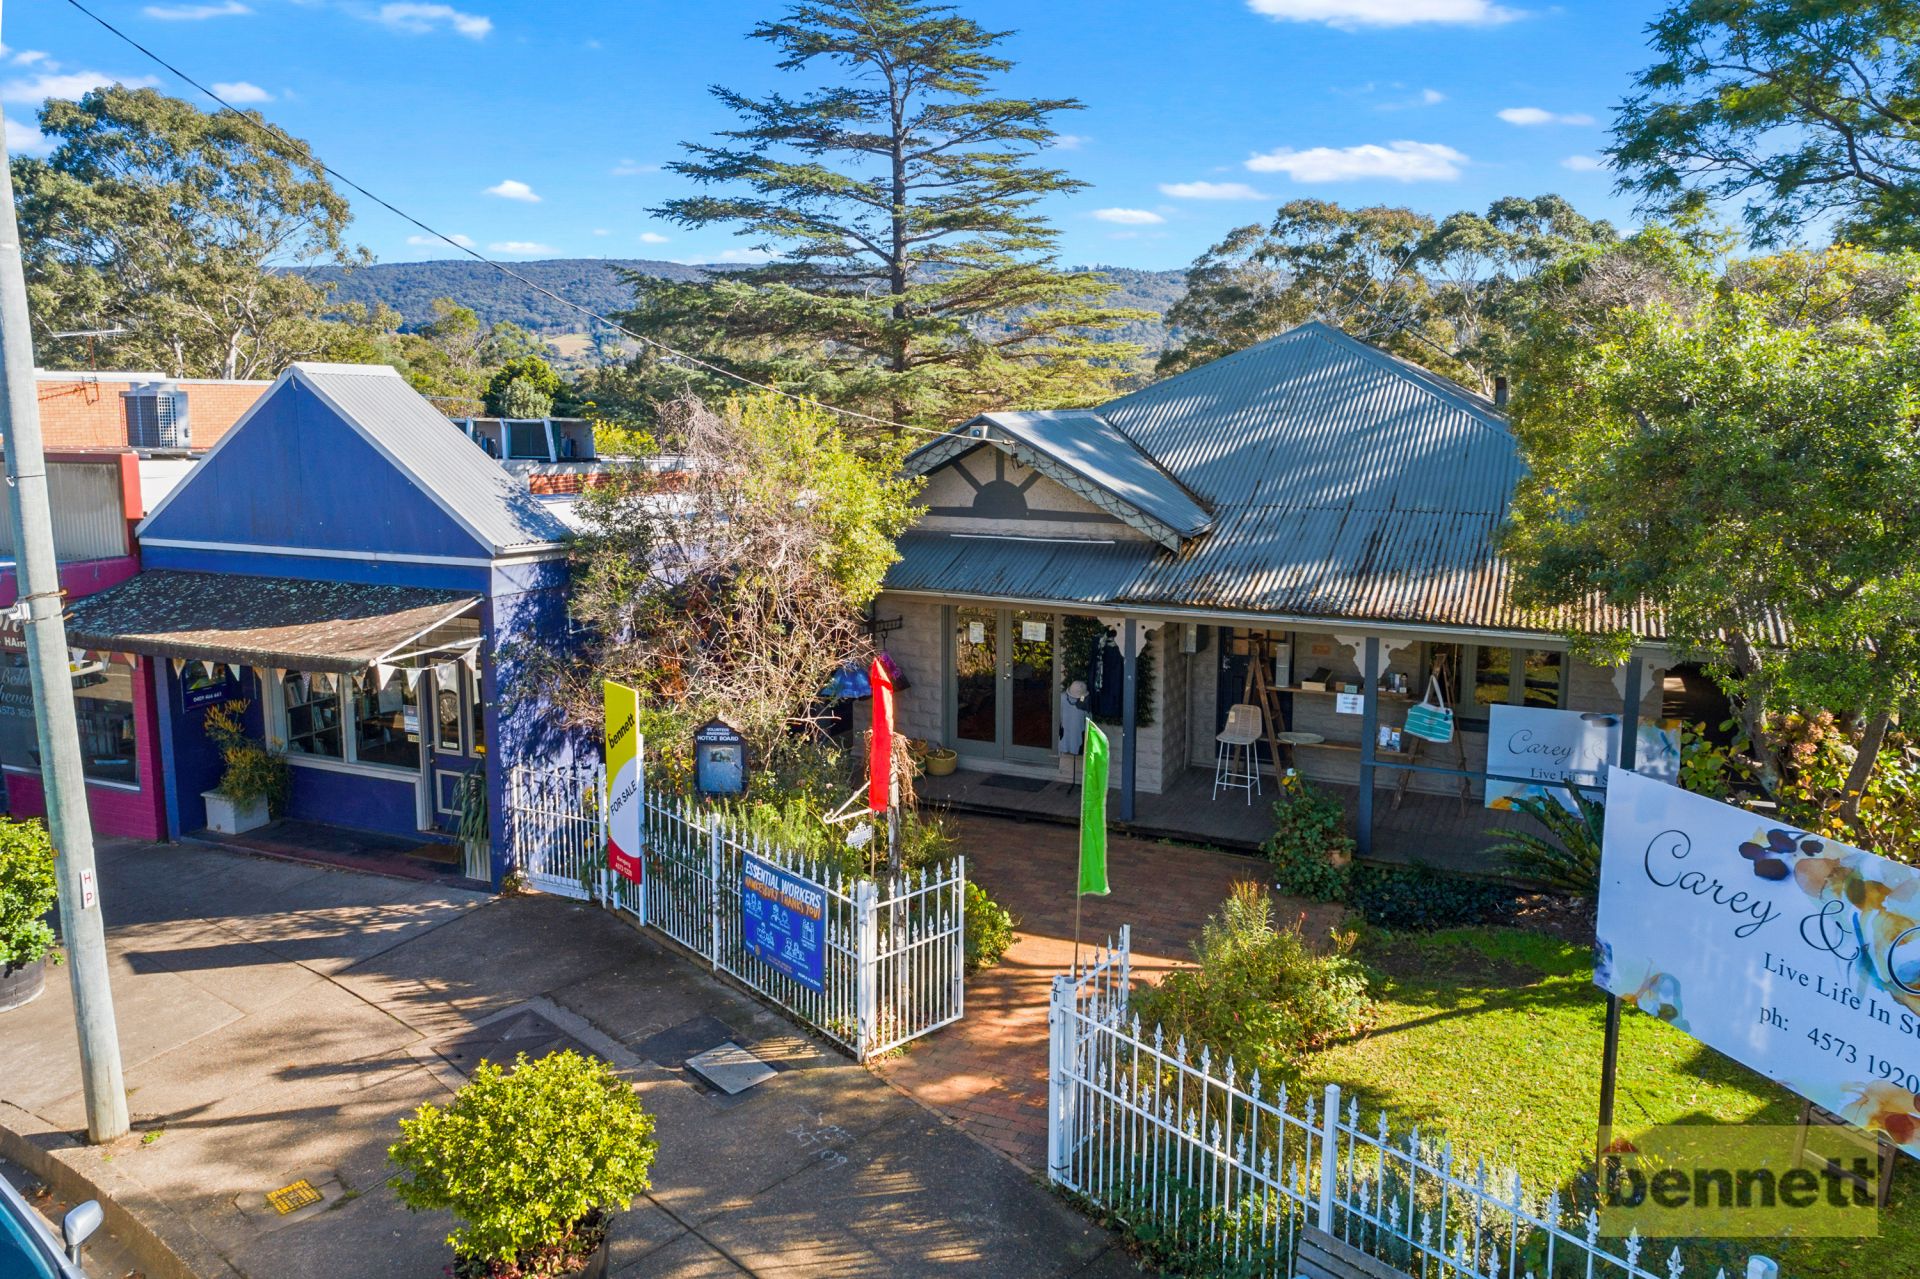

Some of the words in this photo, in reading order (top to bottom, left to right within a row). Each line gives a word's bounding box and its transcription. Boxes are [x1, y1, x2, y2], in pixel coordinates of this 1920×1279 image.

[608, 713, 636, 749] bennett
[1508, 729, 1574, 765] Carey
[1531, 768, 1556, 780] Live
[610, 797, 624, 816] FOR
[621, 779, 637, 803] SALE
[745, 860, 780, 890] ESSENTIAL
[781, 878, 822, 909] WORKERS
[780, 892, 804, 914] THANKS
[1644, 829, 1782, 938] Carey
[1800, 900, 1861, 961] &
[1763, 952, 1809, 987] Live
[1815, 975, 1861, 1010] Life
[1868, 999, 1891, 1025] In
[1760, 1006, 1789, 1031] ph:
[1807, 1027, 1857, 1063] 4573
[1868, 1055, 1920, 1094] 1920
